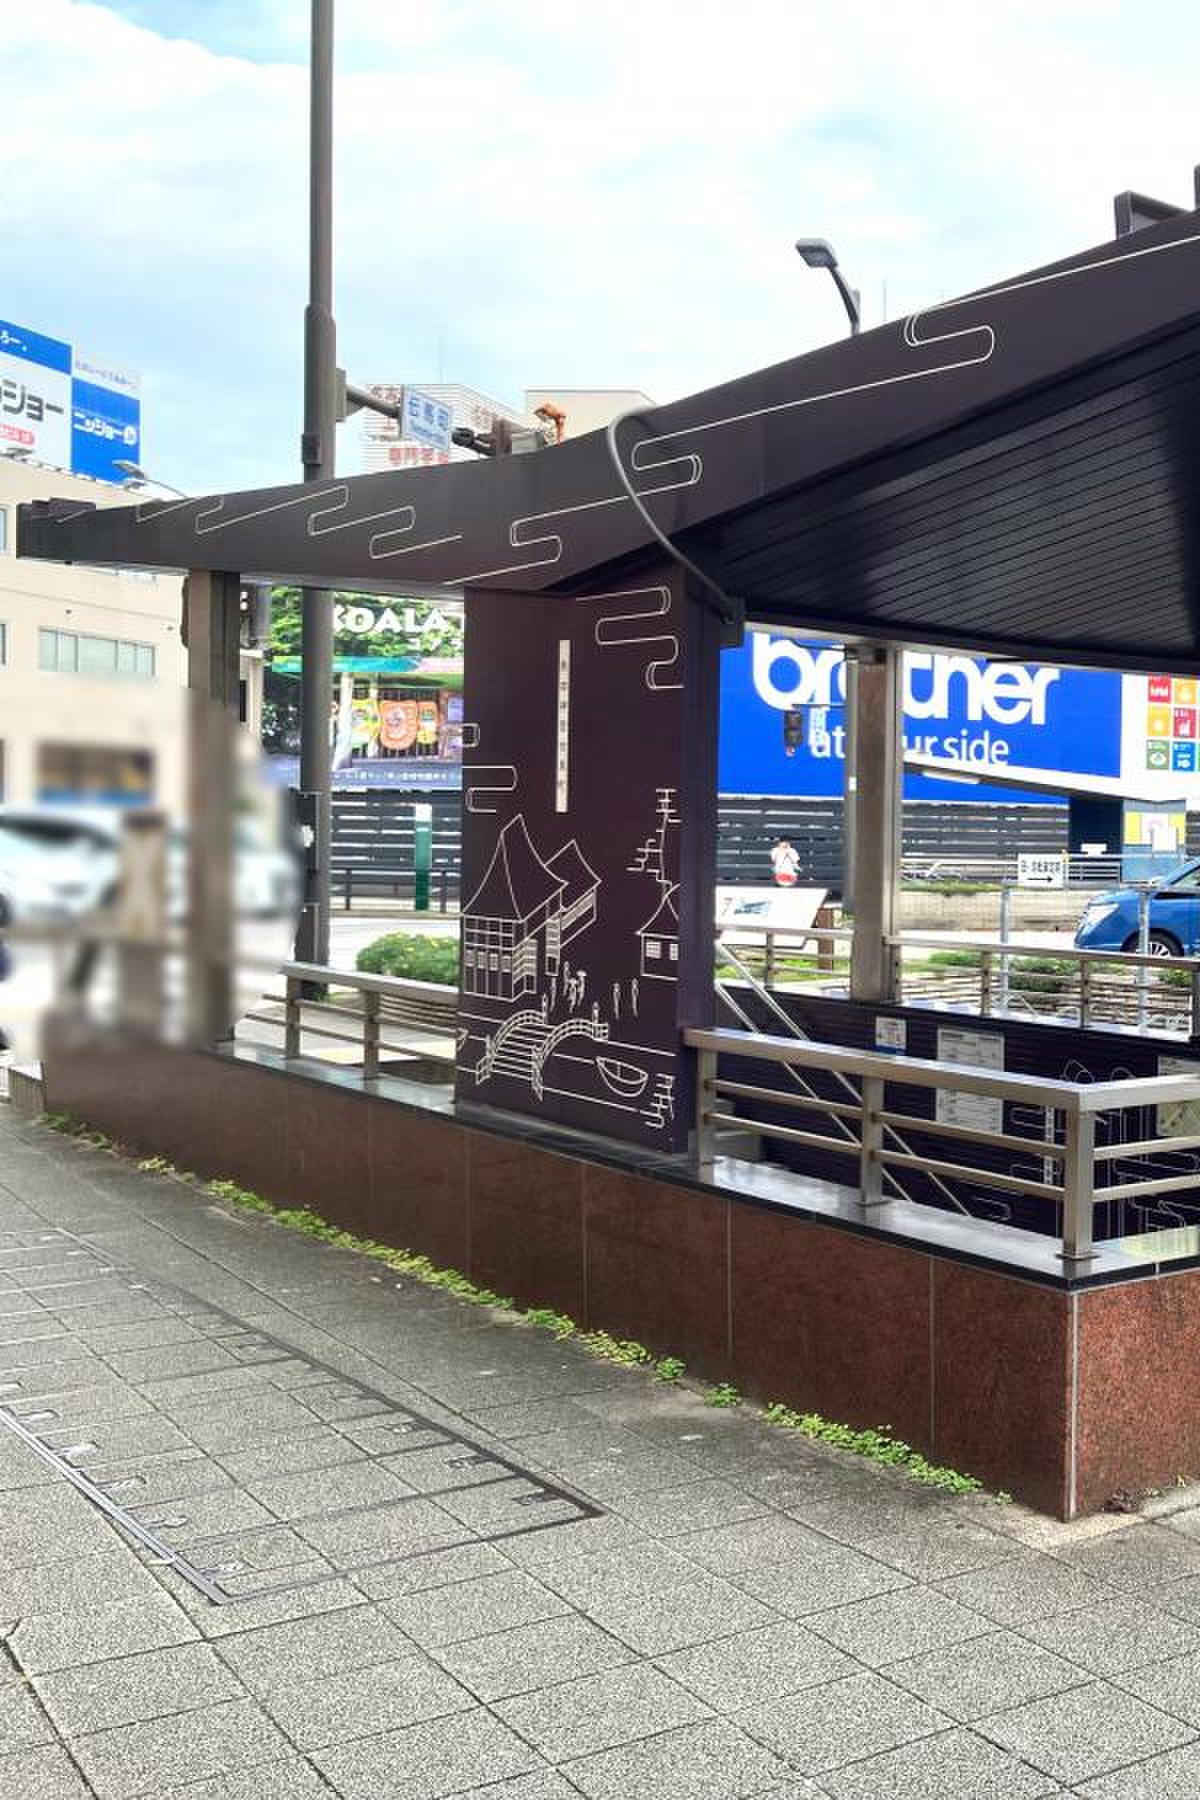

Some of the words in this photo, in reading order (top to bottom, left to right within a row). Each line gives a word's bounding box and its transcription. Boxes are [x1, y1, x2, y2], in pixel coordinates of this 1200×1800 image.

[0, 378, 64, 422] ショー
[752, 633, 1060, 726] brther
[943, 729, 1009, 766] side
